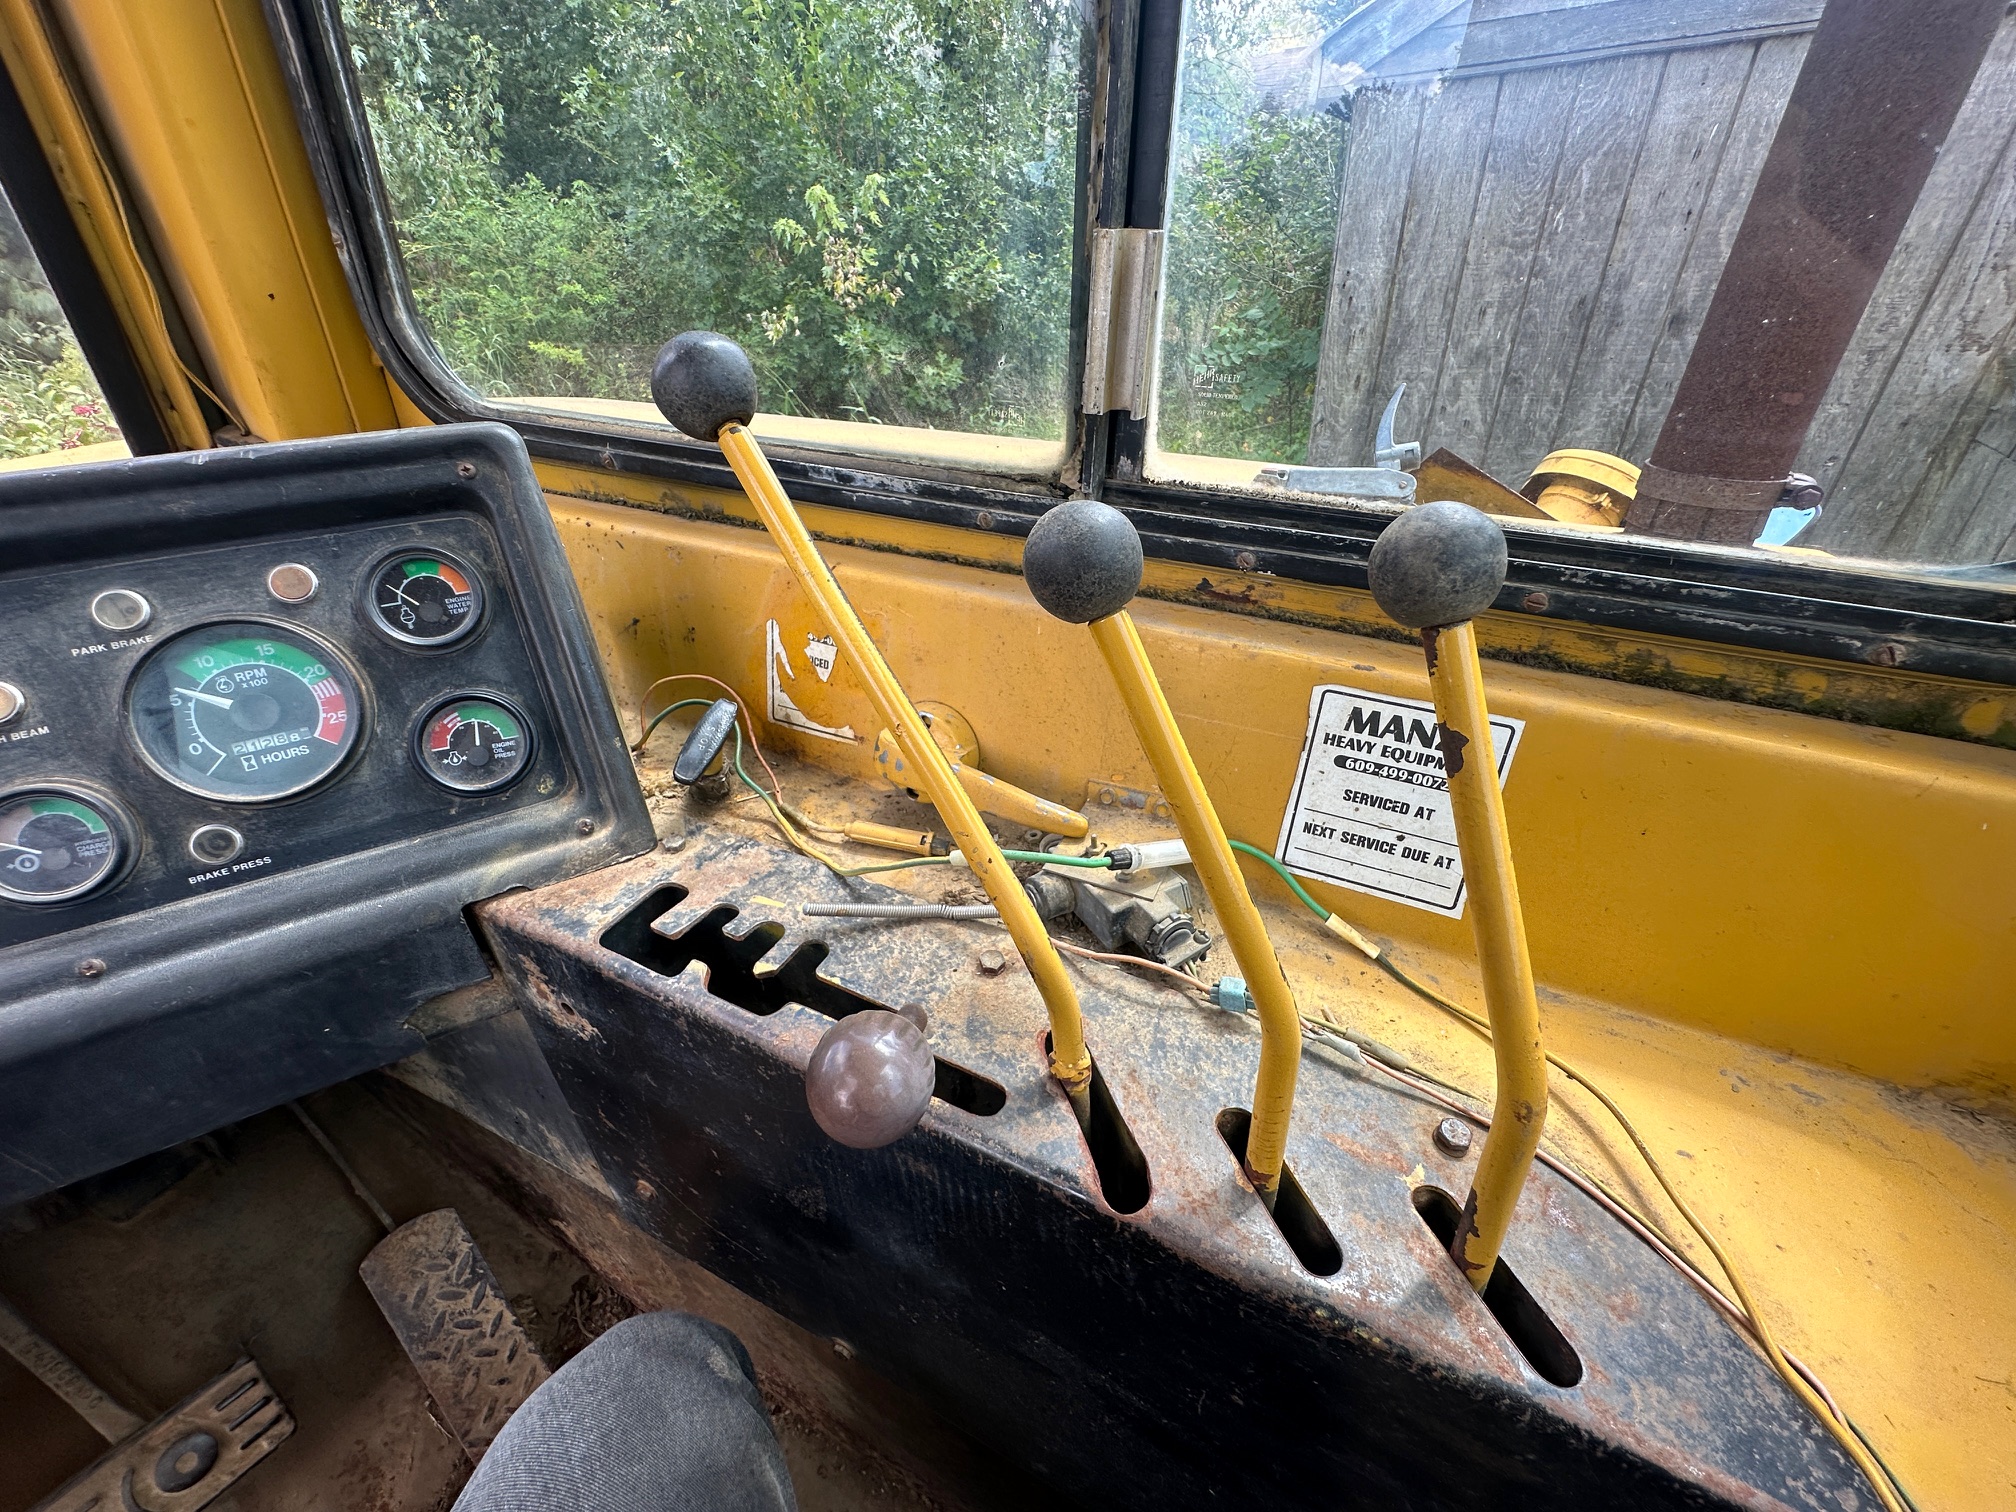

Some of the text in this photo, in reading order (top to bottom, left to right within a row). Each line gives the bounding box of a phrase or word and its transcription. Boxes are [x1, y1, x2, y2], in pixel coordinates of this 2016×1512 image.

[1215, 373, 1241, 383] SAFETY
[444, 595, 472, 604] ENGINE
[446, 601, 472, 610] WATER
[448, 606, 469, 615] TEMP
[71, 634, 154, 657] PARK BRAKE
[254, 643, 275, 657] 15
[192, 655, 214, 669] 10
[233, 667, 268, 682] RPM
[303, 663, 326, 679] 20
[169, 694, 182, 706] 5
[327, 710, 348, 725] 25
[10, 725, 50, 741] BEAM
[188, 743, 203, 756] 0
[491, 740, 516, 749] ENGINE
[1323, 732, 1377, 755] HEAVY
[260, 744, 310, 765] HOURS
[494, 751, 517, 759] PRESS
[1345, 757, 1450, 792] 609-499-0072
[1342, 789, 1436, 821] SERVICED AT
[1302, 821, 1456, 871] NEXT SERVICE DUE AT
[188, 856, 272, 885] BRAKE PRESS
